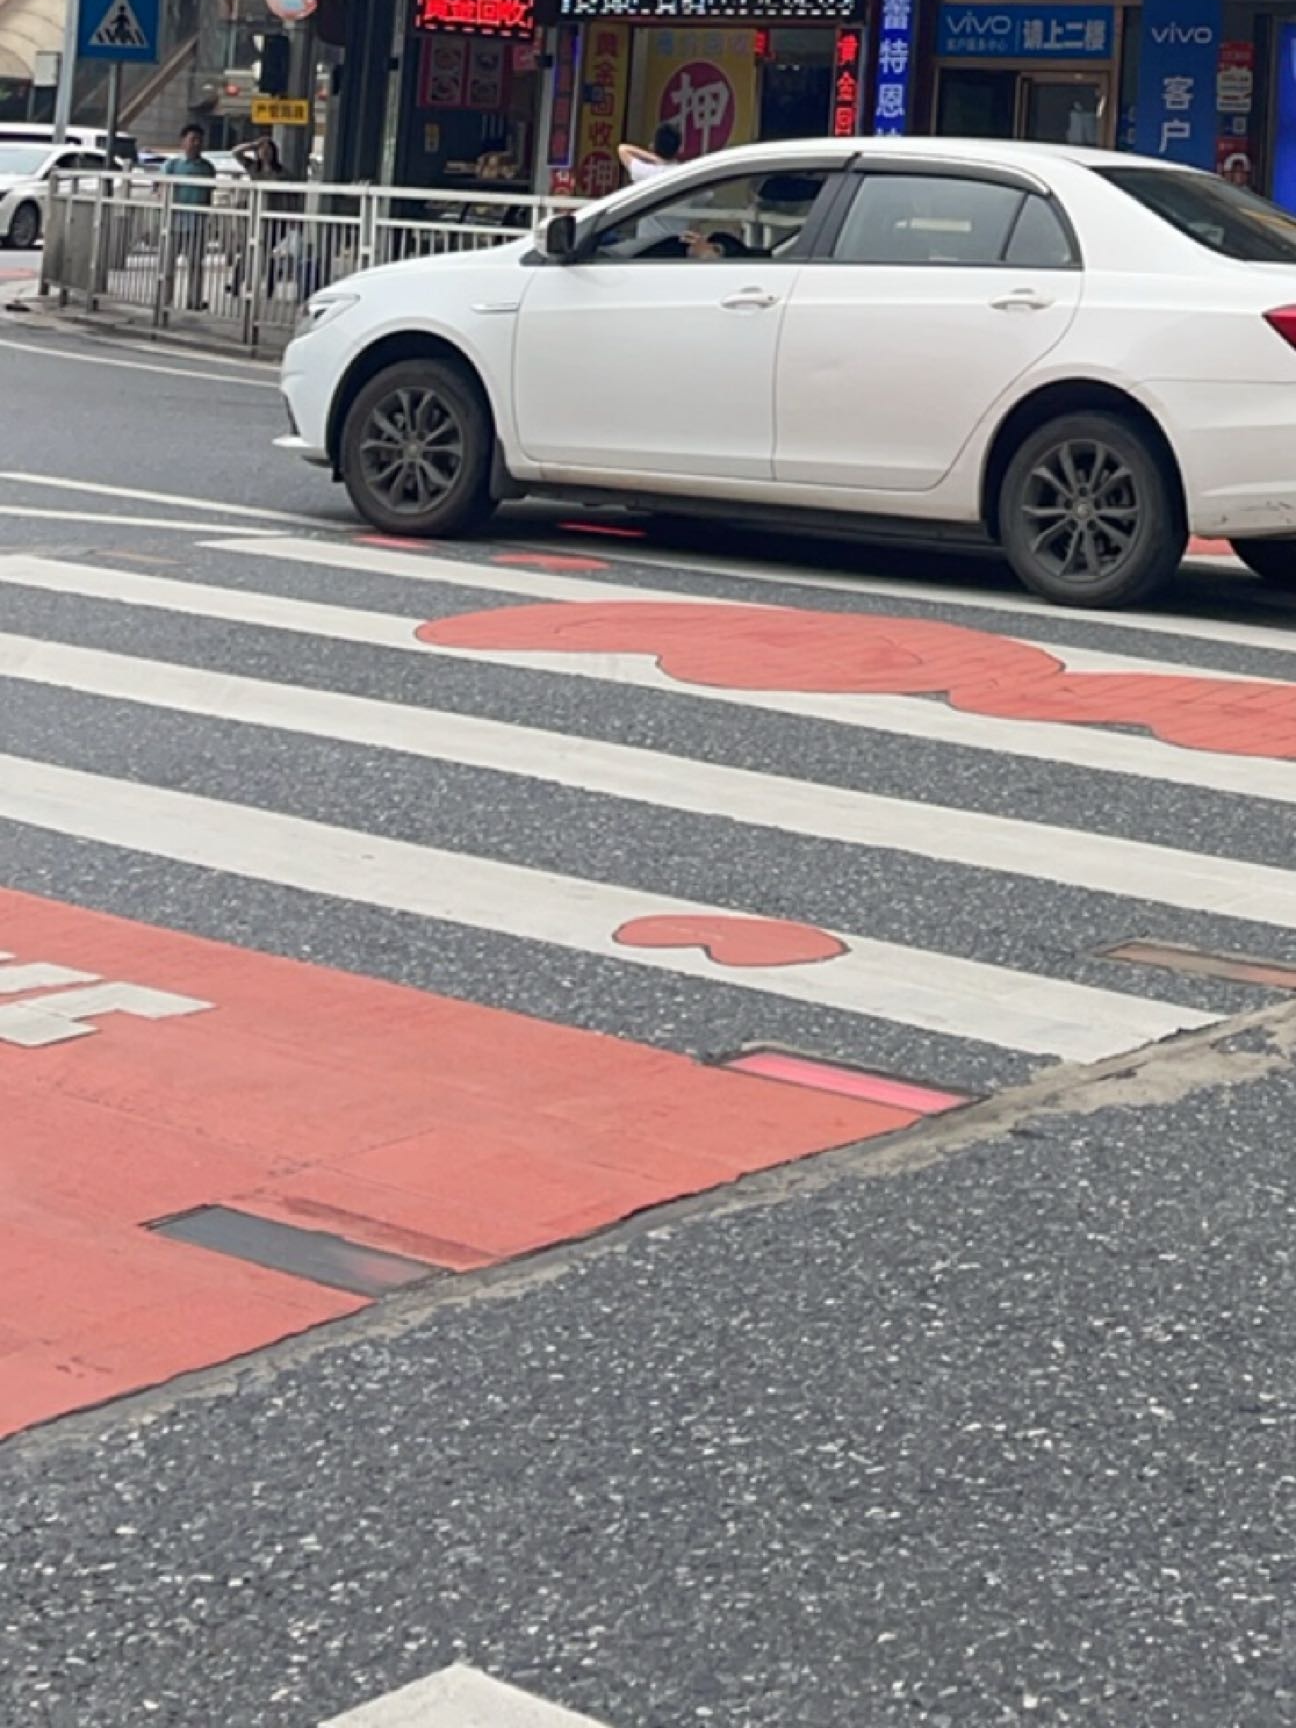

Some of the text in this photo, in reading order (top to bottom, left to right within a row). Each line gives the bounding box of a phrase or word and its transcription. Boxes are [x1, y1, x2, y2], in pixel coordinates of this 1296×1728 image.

[946, 10, 1012, 35] vivo
[1151, 21, 1213, 44] vivo
[658, 71, 731, 154] 押
[1158, 76, 1195, 153] 客户
